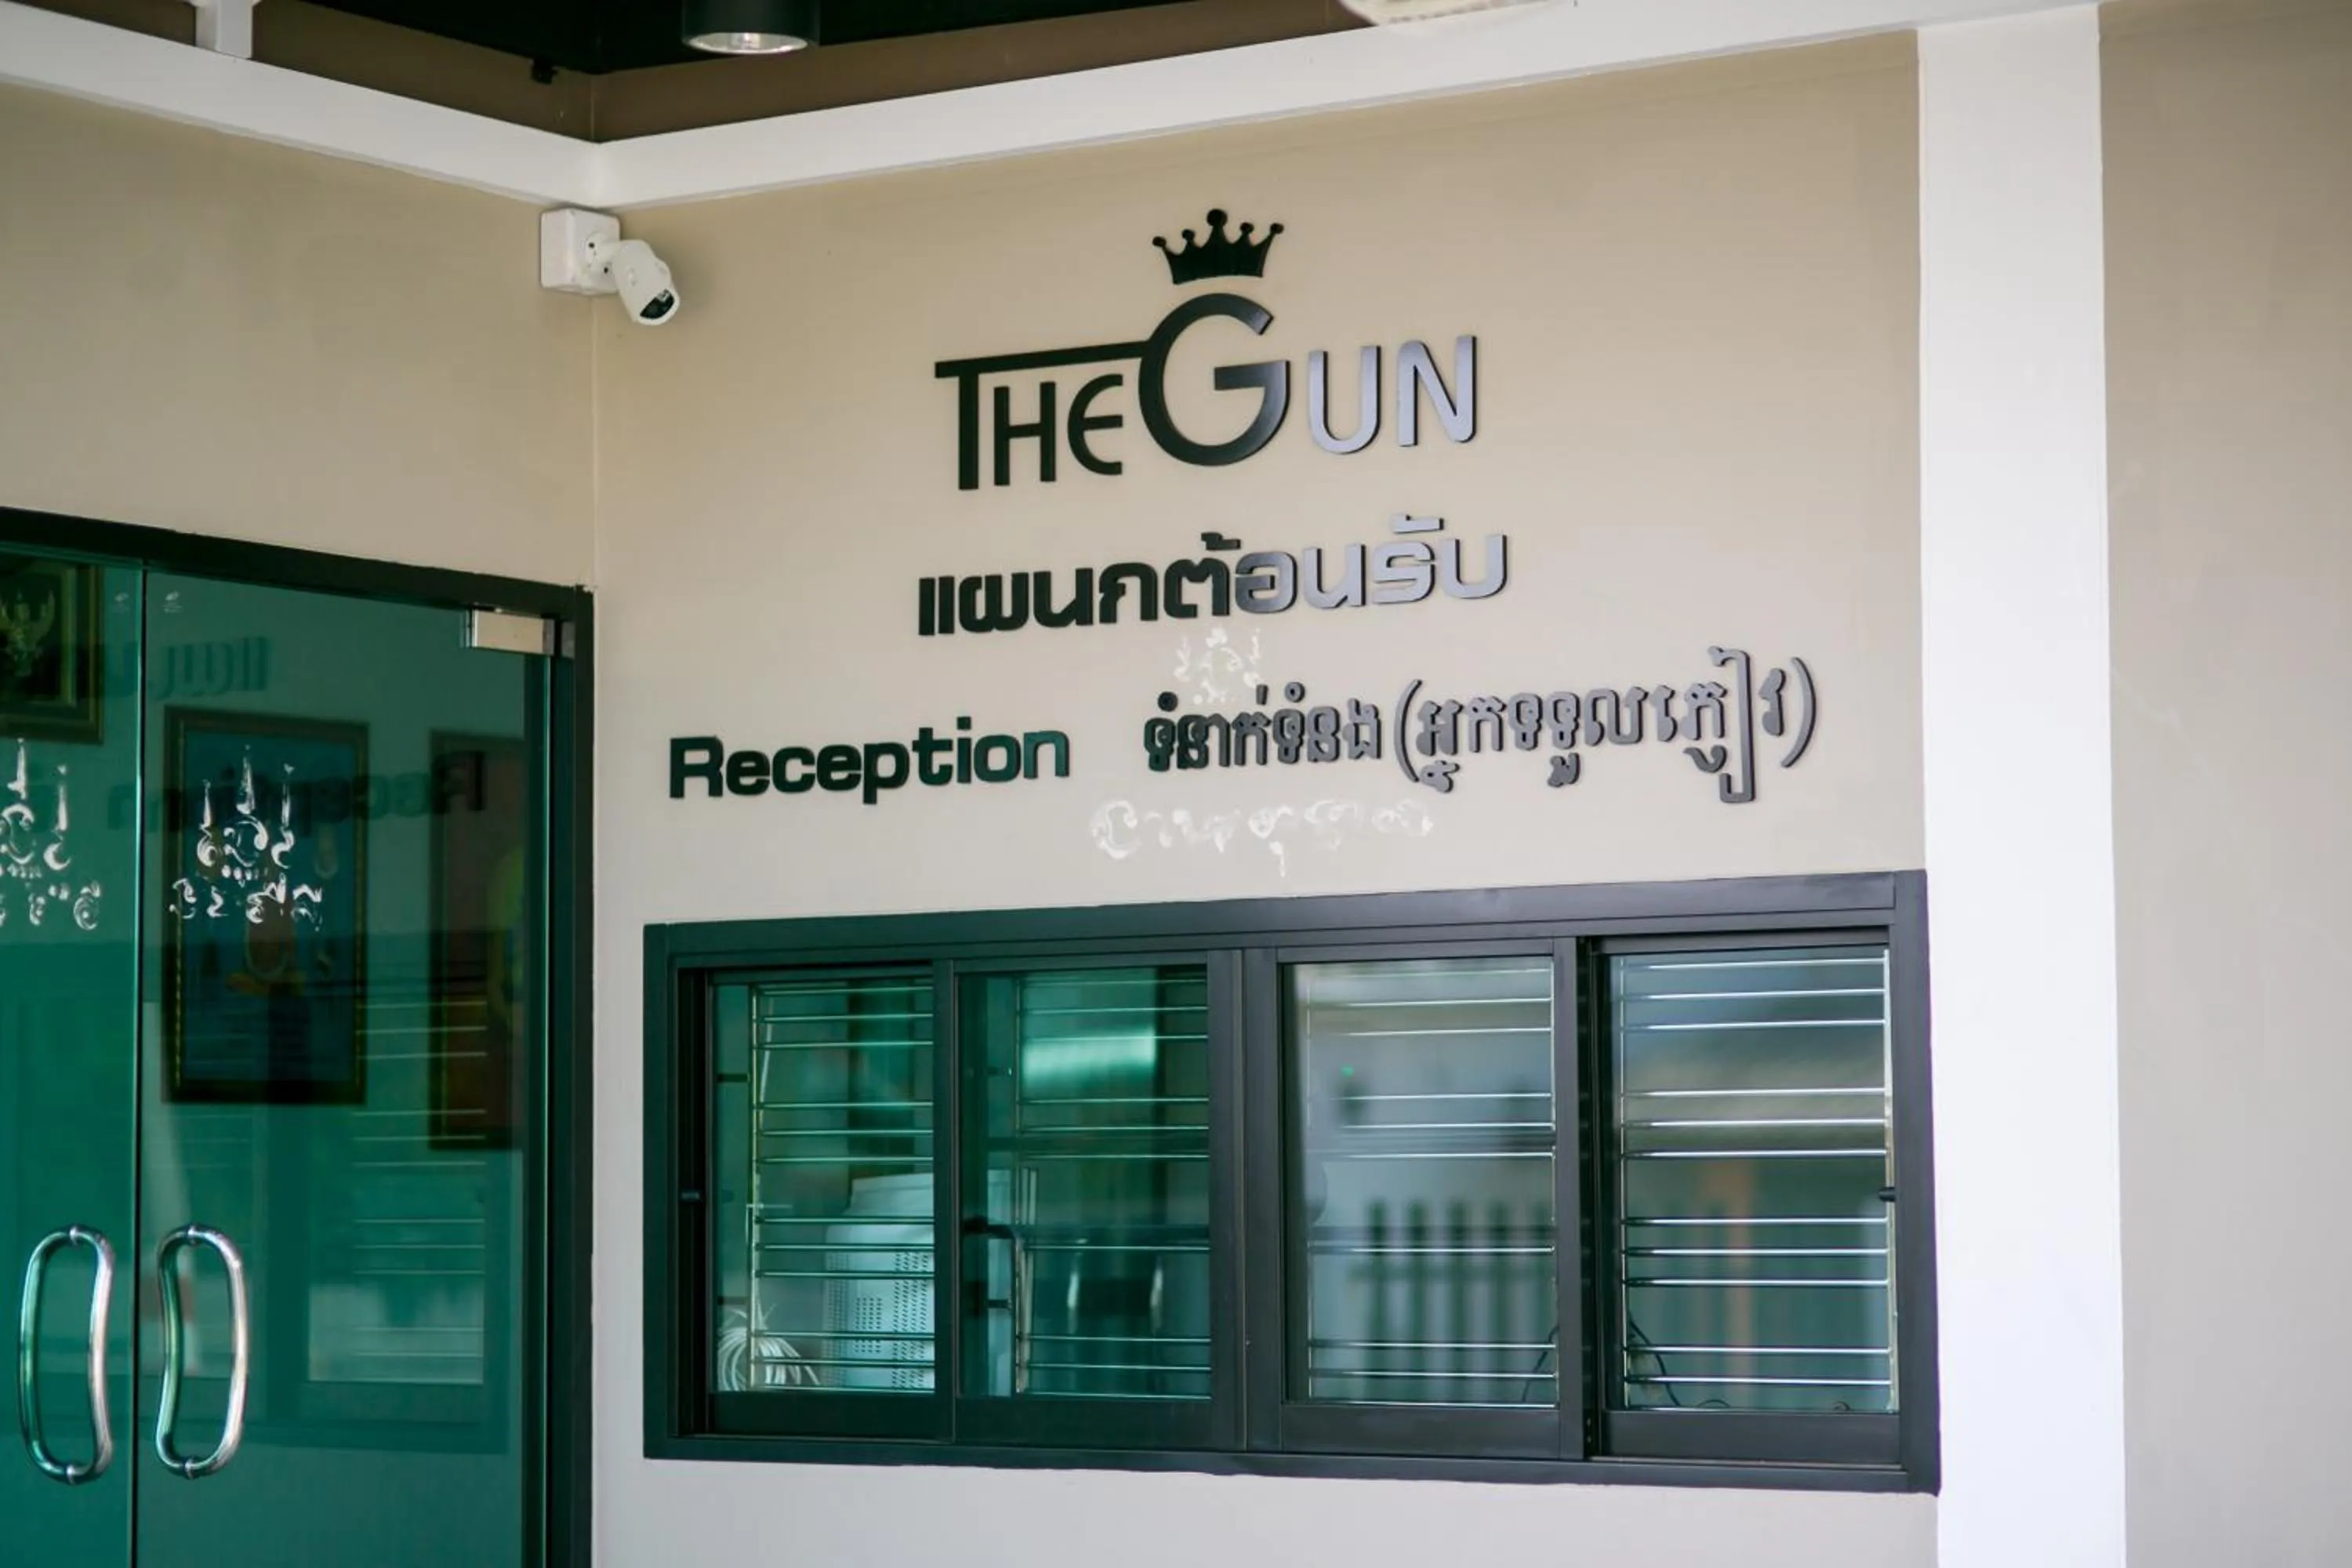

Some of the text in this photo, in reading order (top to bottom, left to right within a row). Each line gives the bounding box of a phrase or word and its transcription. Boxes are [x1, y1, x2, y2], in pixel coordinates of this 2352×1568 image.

[935, 292, 1477, 490] THE GUN
[918, 514, 1507, 636] แผนกต้อนรับ
[670, 716, 1070, 806] Reception
